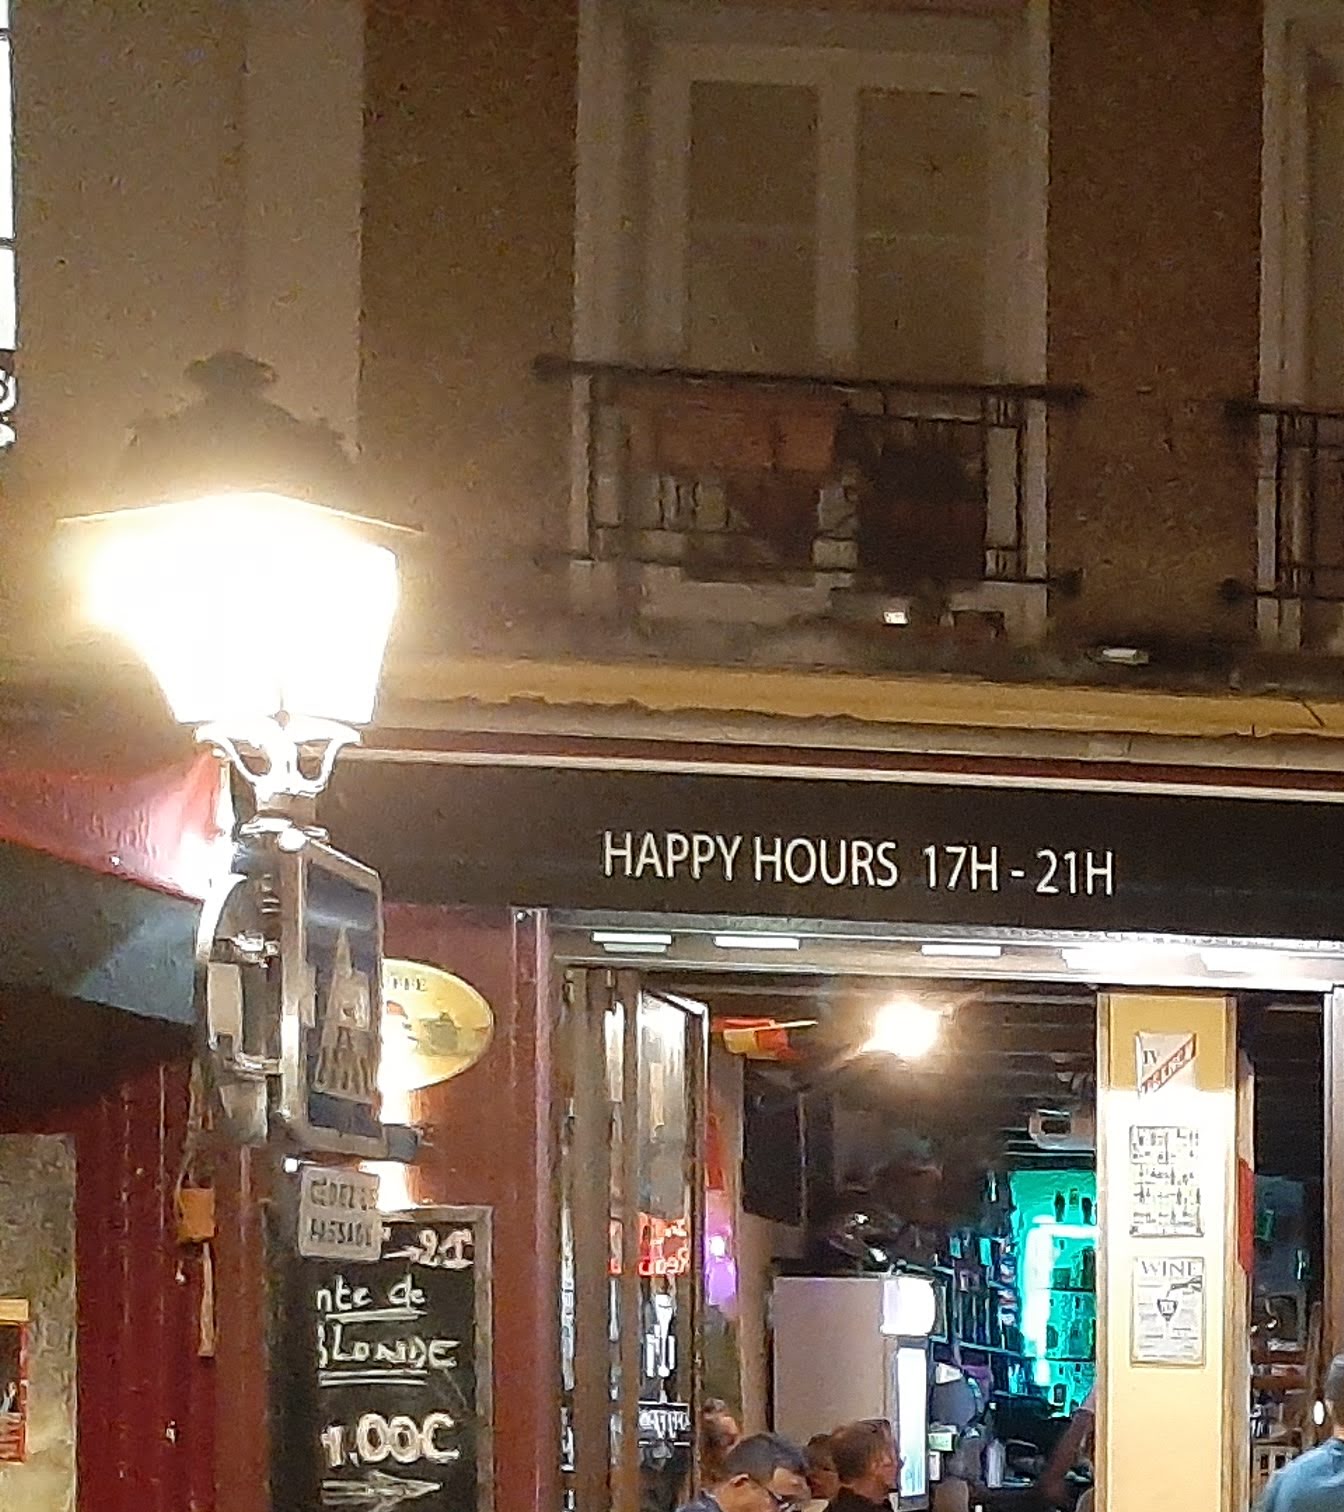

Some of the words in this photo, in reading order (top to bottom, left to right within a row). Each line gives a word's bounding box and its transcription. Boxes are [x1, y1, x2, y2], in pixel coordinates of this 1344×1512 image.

[603, 830, 742, 882] HAPPY
[754, 836, 898, 887] HOURS
[922, 844, 999, 891] 17H
[1034, 848, 1115, 896] 21H
